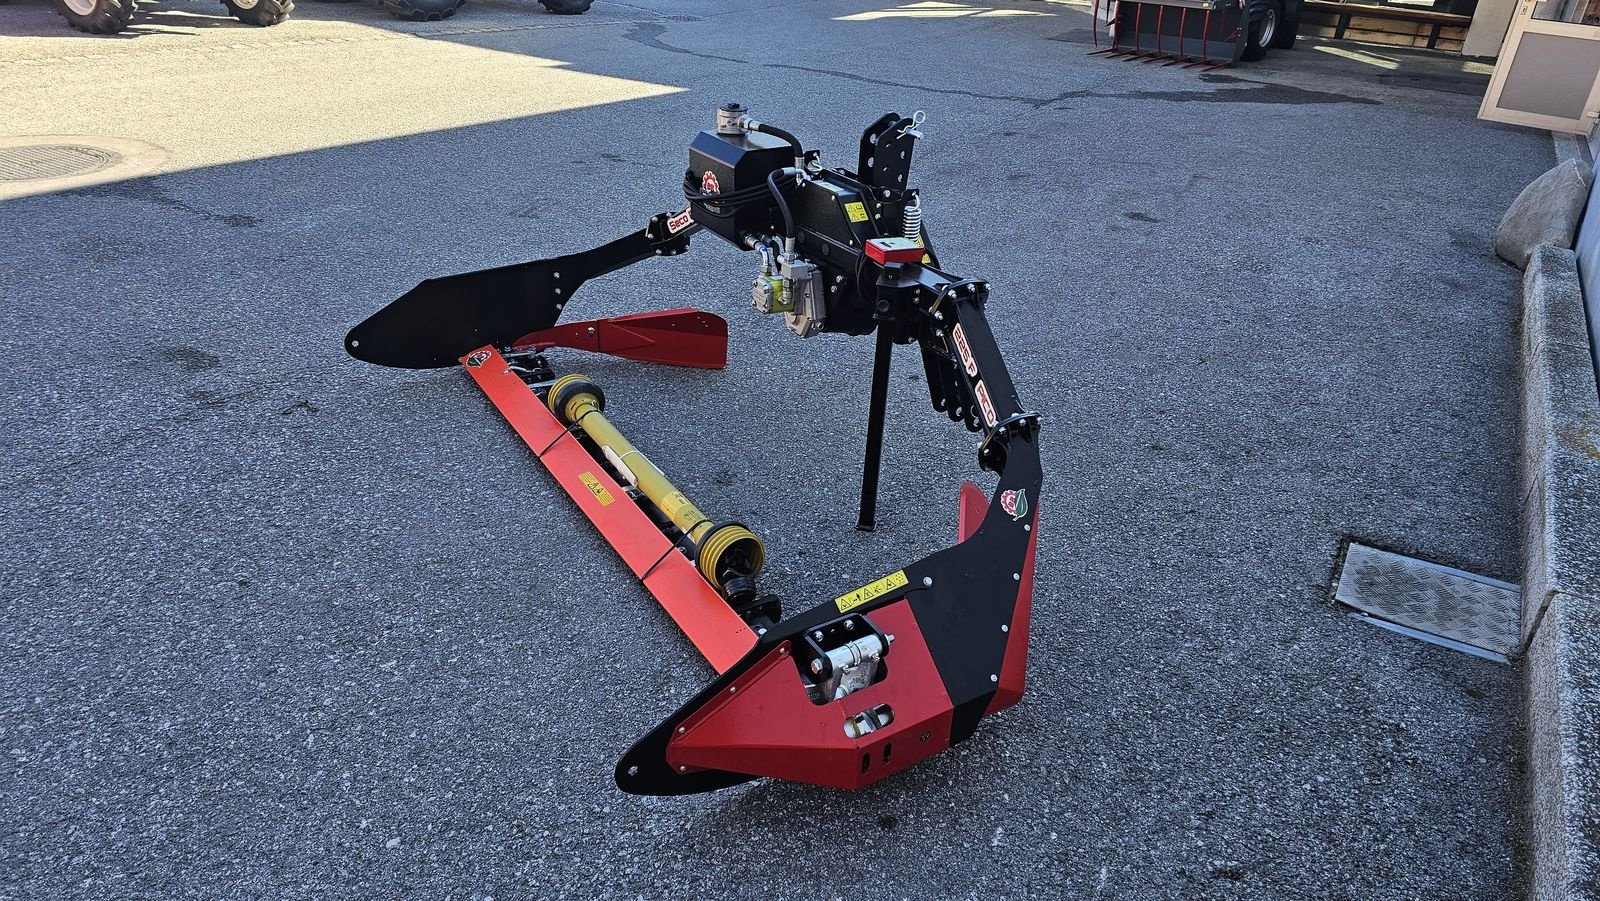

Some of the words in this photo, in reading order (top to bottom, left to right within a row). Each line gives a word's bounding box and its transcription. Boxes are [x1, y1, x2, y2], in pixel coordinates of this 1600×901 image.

[669, 215, 689, 230] Seco
[954, 327, 970, 362] 225
[967, 362, 976, 374] F
[976, 384, 995, 424] PICO
